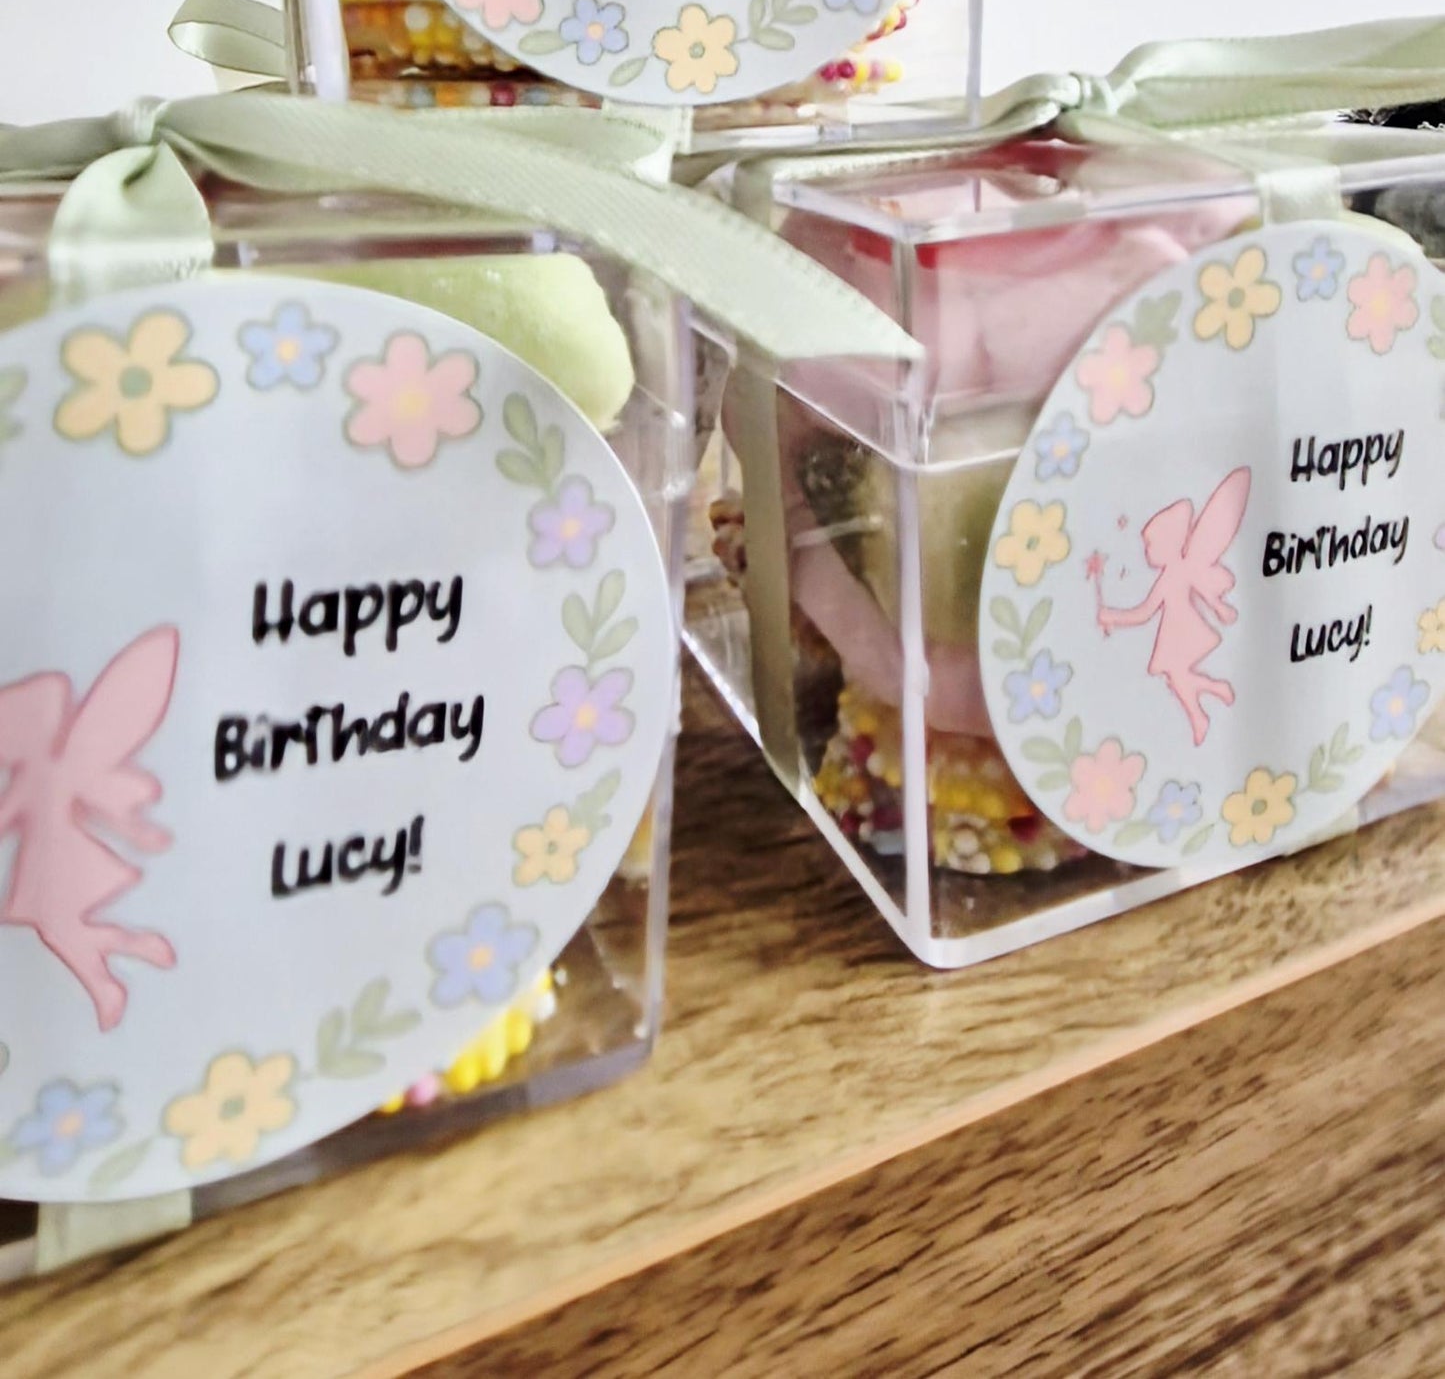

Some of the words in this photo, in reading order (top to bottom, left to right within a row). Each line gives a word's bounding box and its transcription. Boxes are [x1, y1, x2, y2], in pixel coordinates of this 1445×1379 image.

[1289, 427, 1406, 492] Happy
[1261, 513, 1410, 579] Birthday
[251, 573, 464, 658] Happy
[1289, 604, 1375, 664] Lucy!
[213, 691, 486, 783] Birthday
[270, 814, 426, 898] Lucy!
